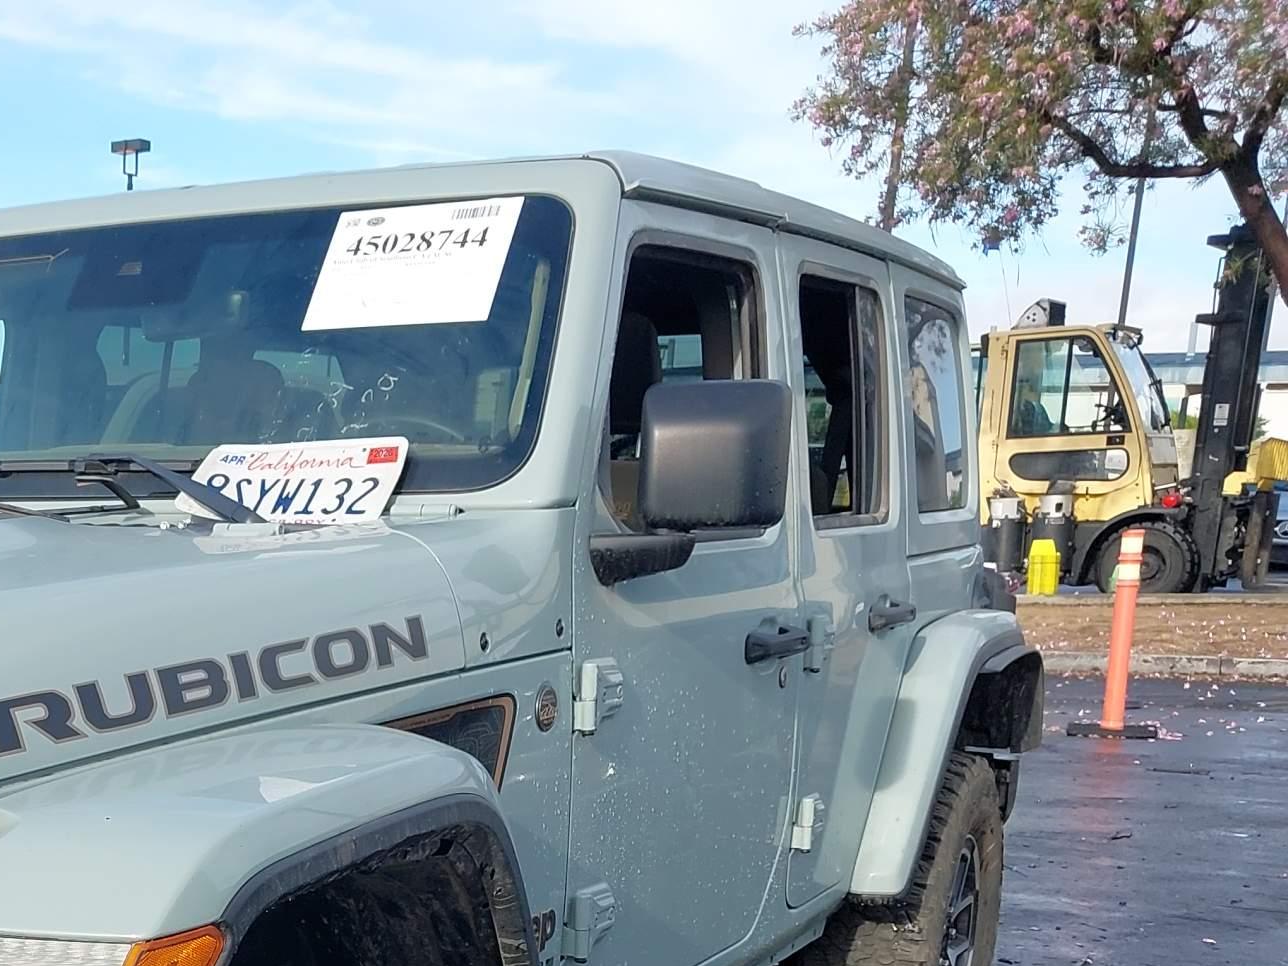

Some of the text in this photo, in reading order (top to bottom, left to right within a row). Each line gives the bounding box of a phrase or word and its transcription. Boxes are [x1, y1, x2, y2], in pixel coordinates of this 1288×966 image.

[345, 225, 490, 256] 45028744
[218, 449, 366, 476] APR California
